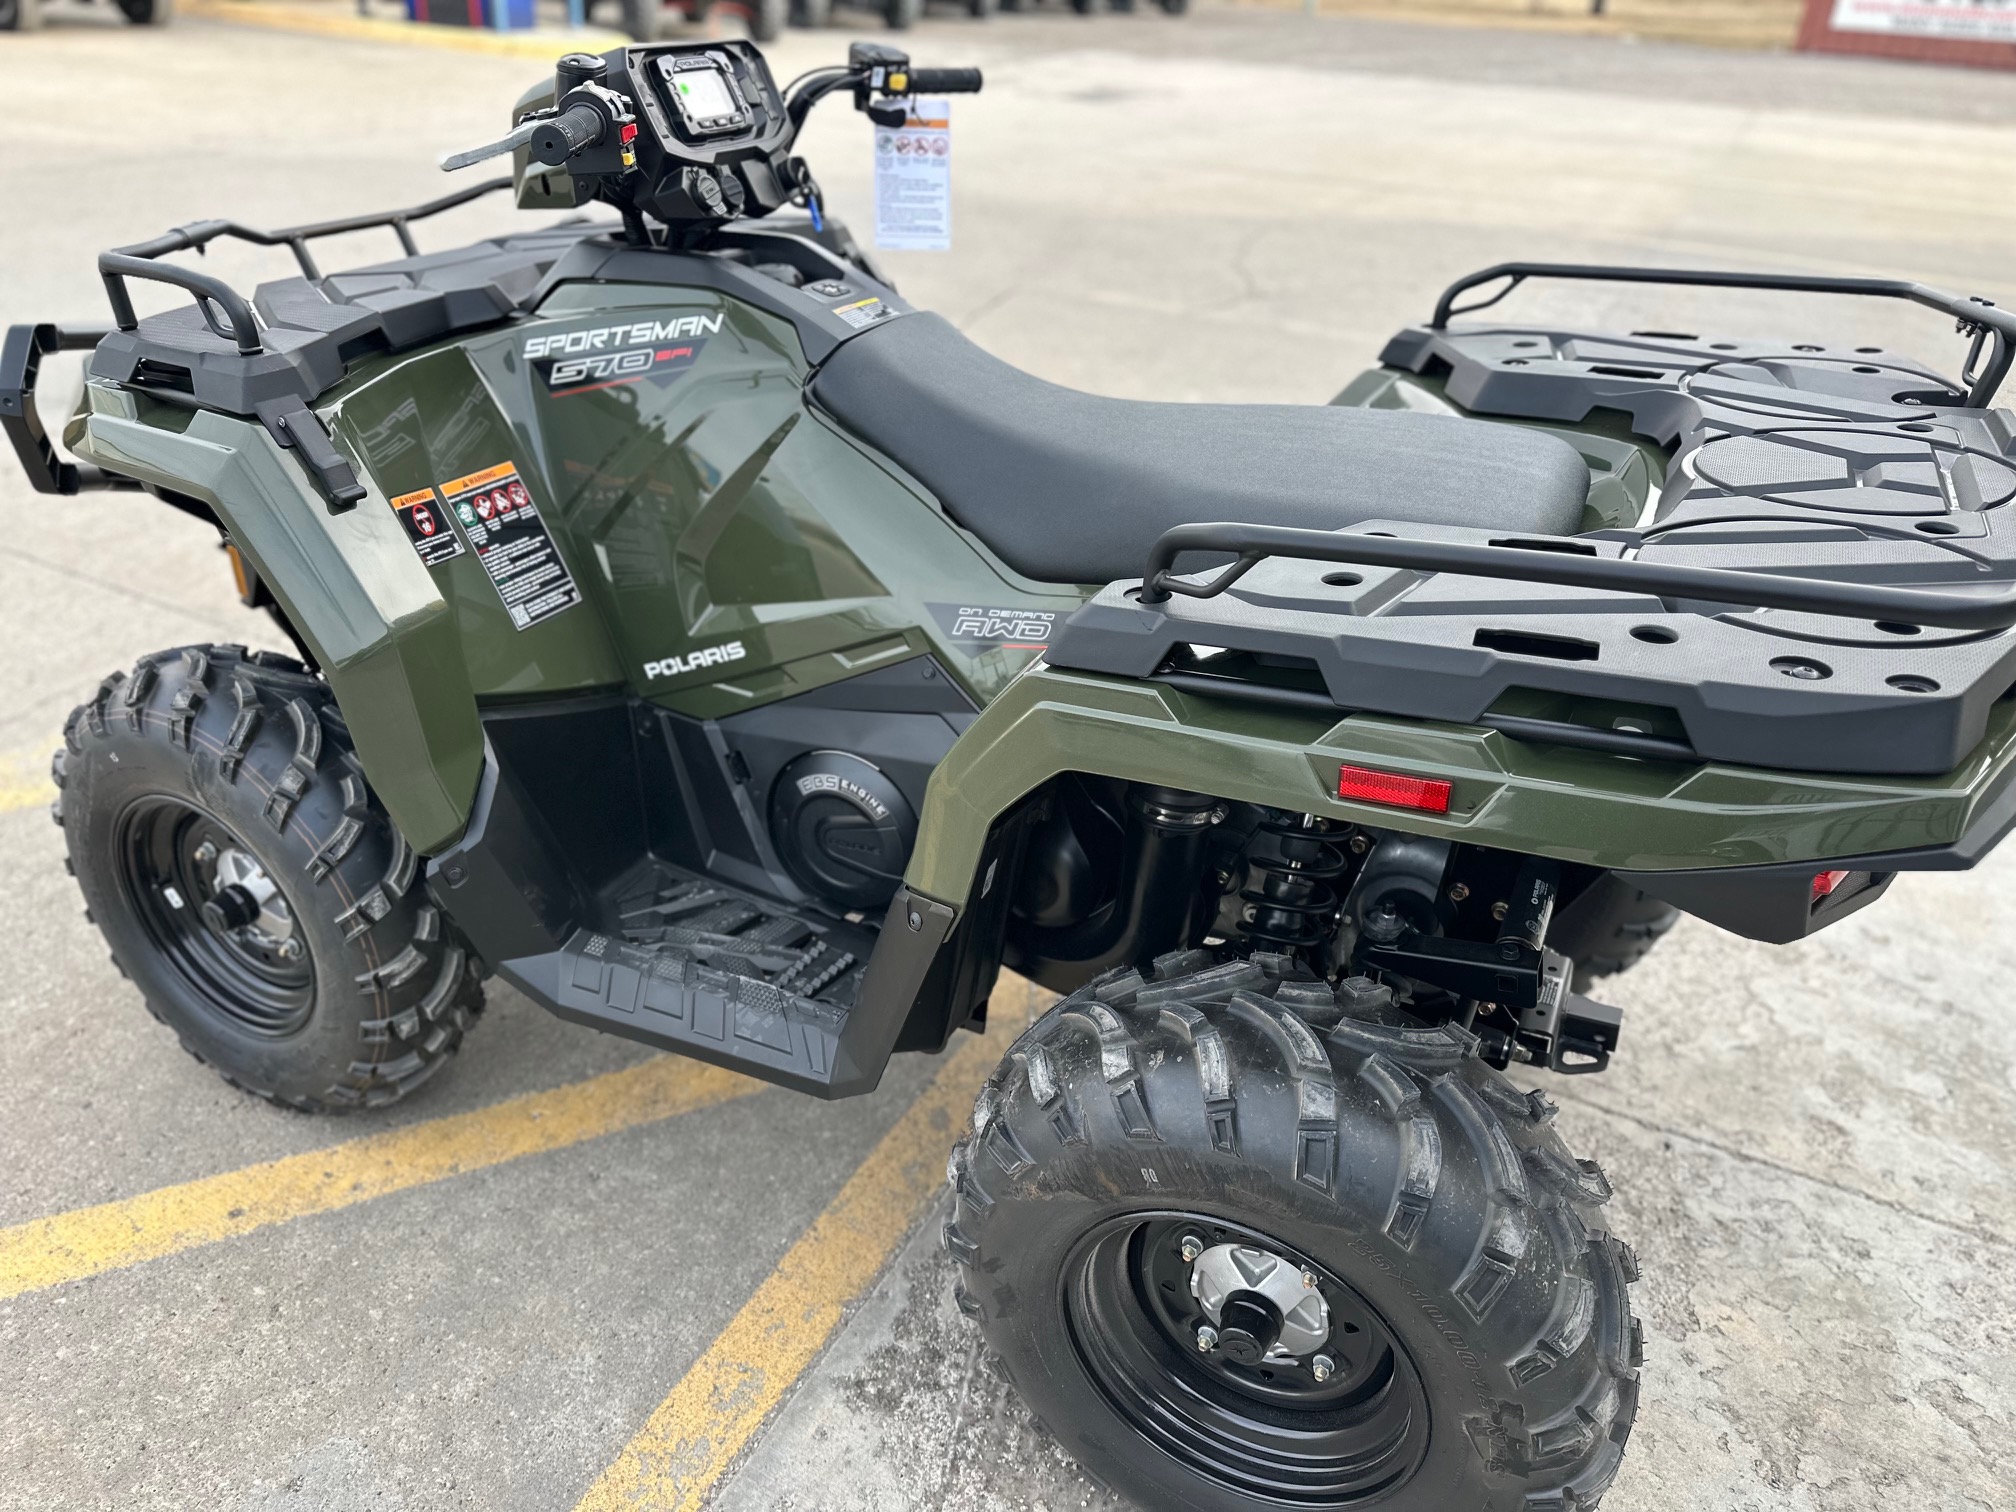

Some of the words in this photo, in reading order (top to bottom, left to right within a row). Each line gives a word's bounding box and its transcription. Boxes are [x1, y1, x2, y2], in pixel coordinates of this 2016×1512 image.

[522, 313, 725, 360] SPORTSMAN
[550, 347, 655, 386] 570
[655, 346, 693, 362] EFI
[470, 471, 496, 485] WARNING
[406, 493, 427, 504] WARNING
[422, 521, 432, 533] 16
[958, 607, 983, 615] ON
[988, 609, 1056, 621] DEMAND
[952, 616, 1052, 641] AWD
[643, 640, 746, 681] POLARIS
[801, 775, 838, 792] EBS
[841, 779, 885, 815] ENGINE
